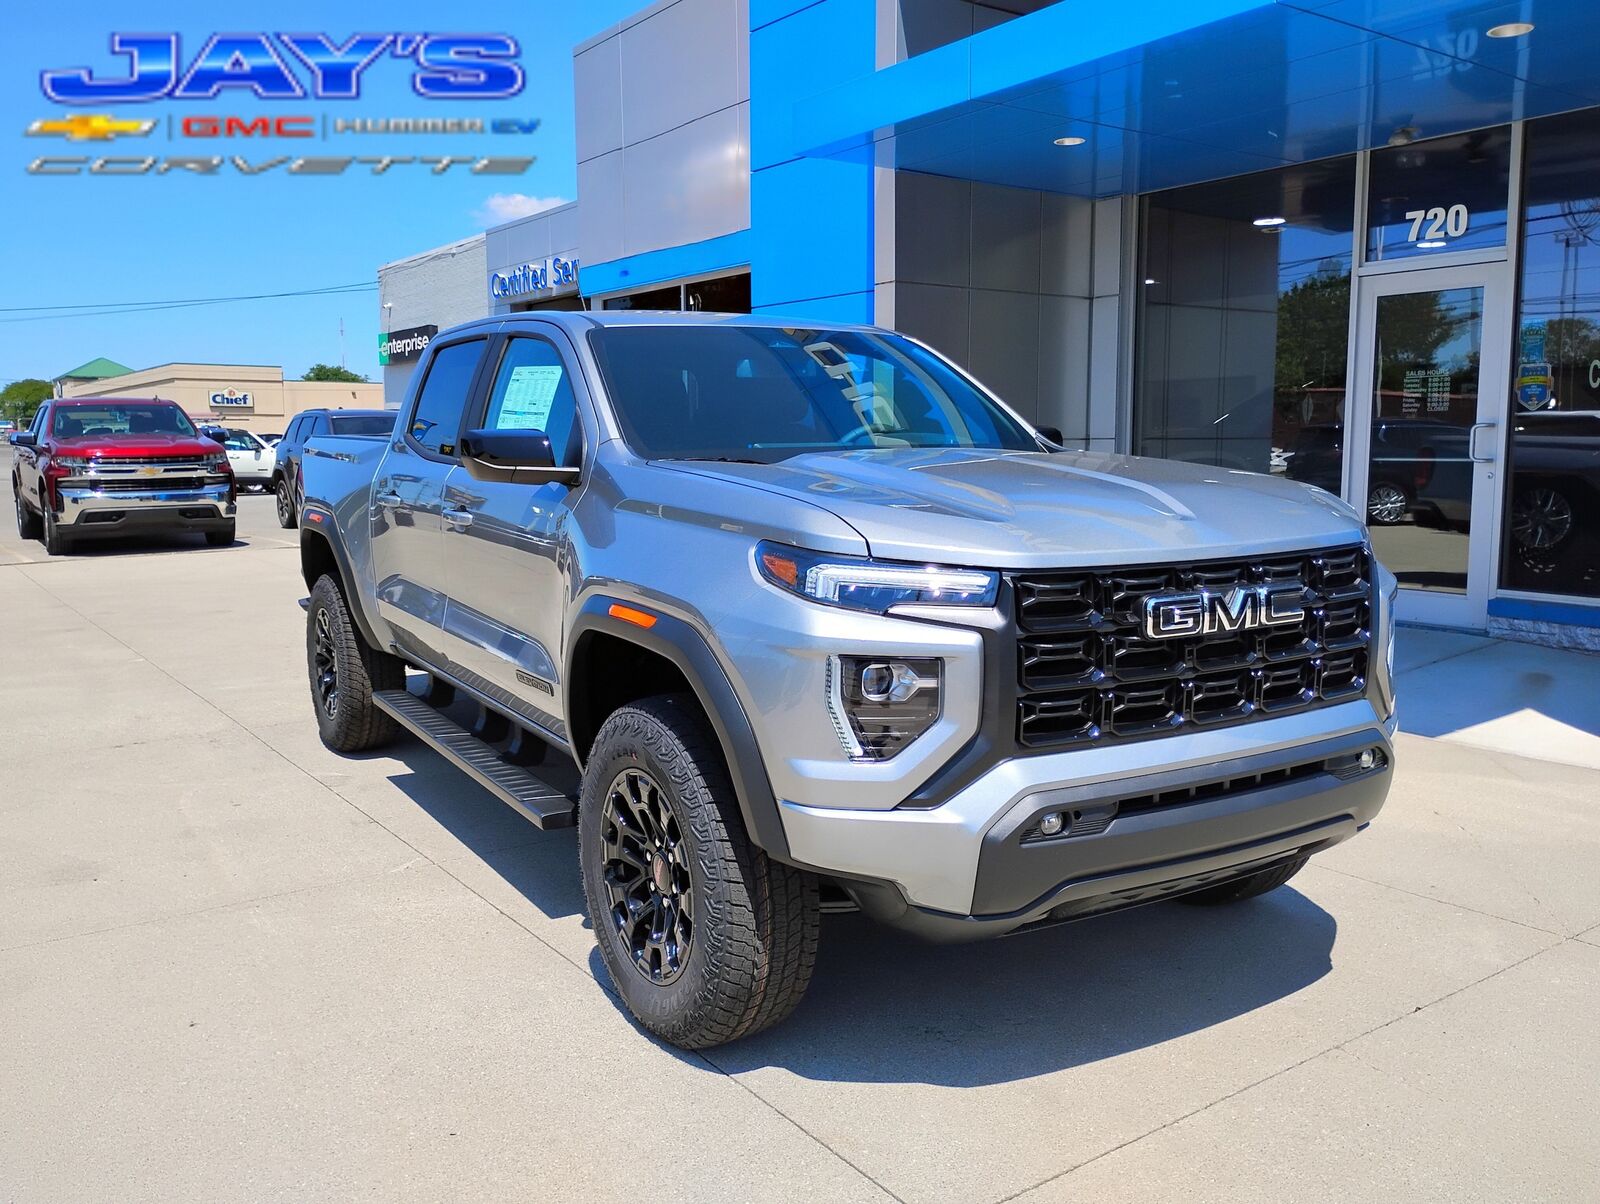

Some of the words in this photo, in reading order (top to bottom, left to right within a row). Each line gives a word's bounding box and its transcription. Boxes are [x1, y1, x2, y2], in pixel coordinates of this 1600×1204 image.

[1406, 204, 1469, 243] 720
[491, 259, 548, 299] Certified
[553, 257, 580, 286] Ser
[381, 332, 430, 356] enterprise
[211, 393, 249, 405] Chief
[1143, 585, 1306, 640] GMC
